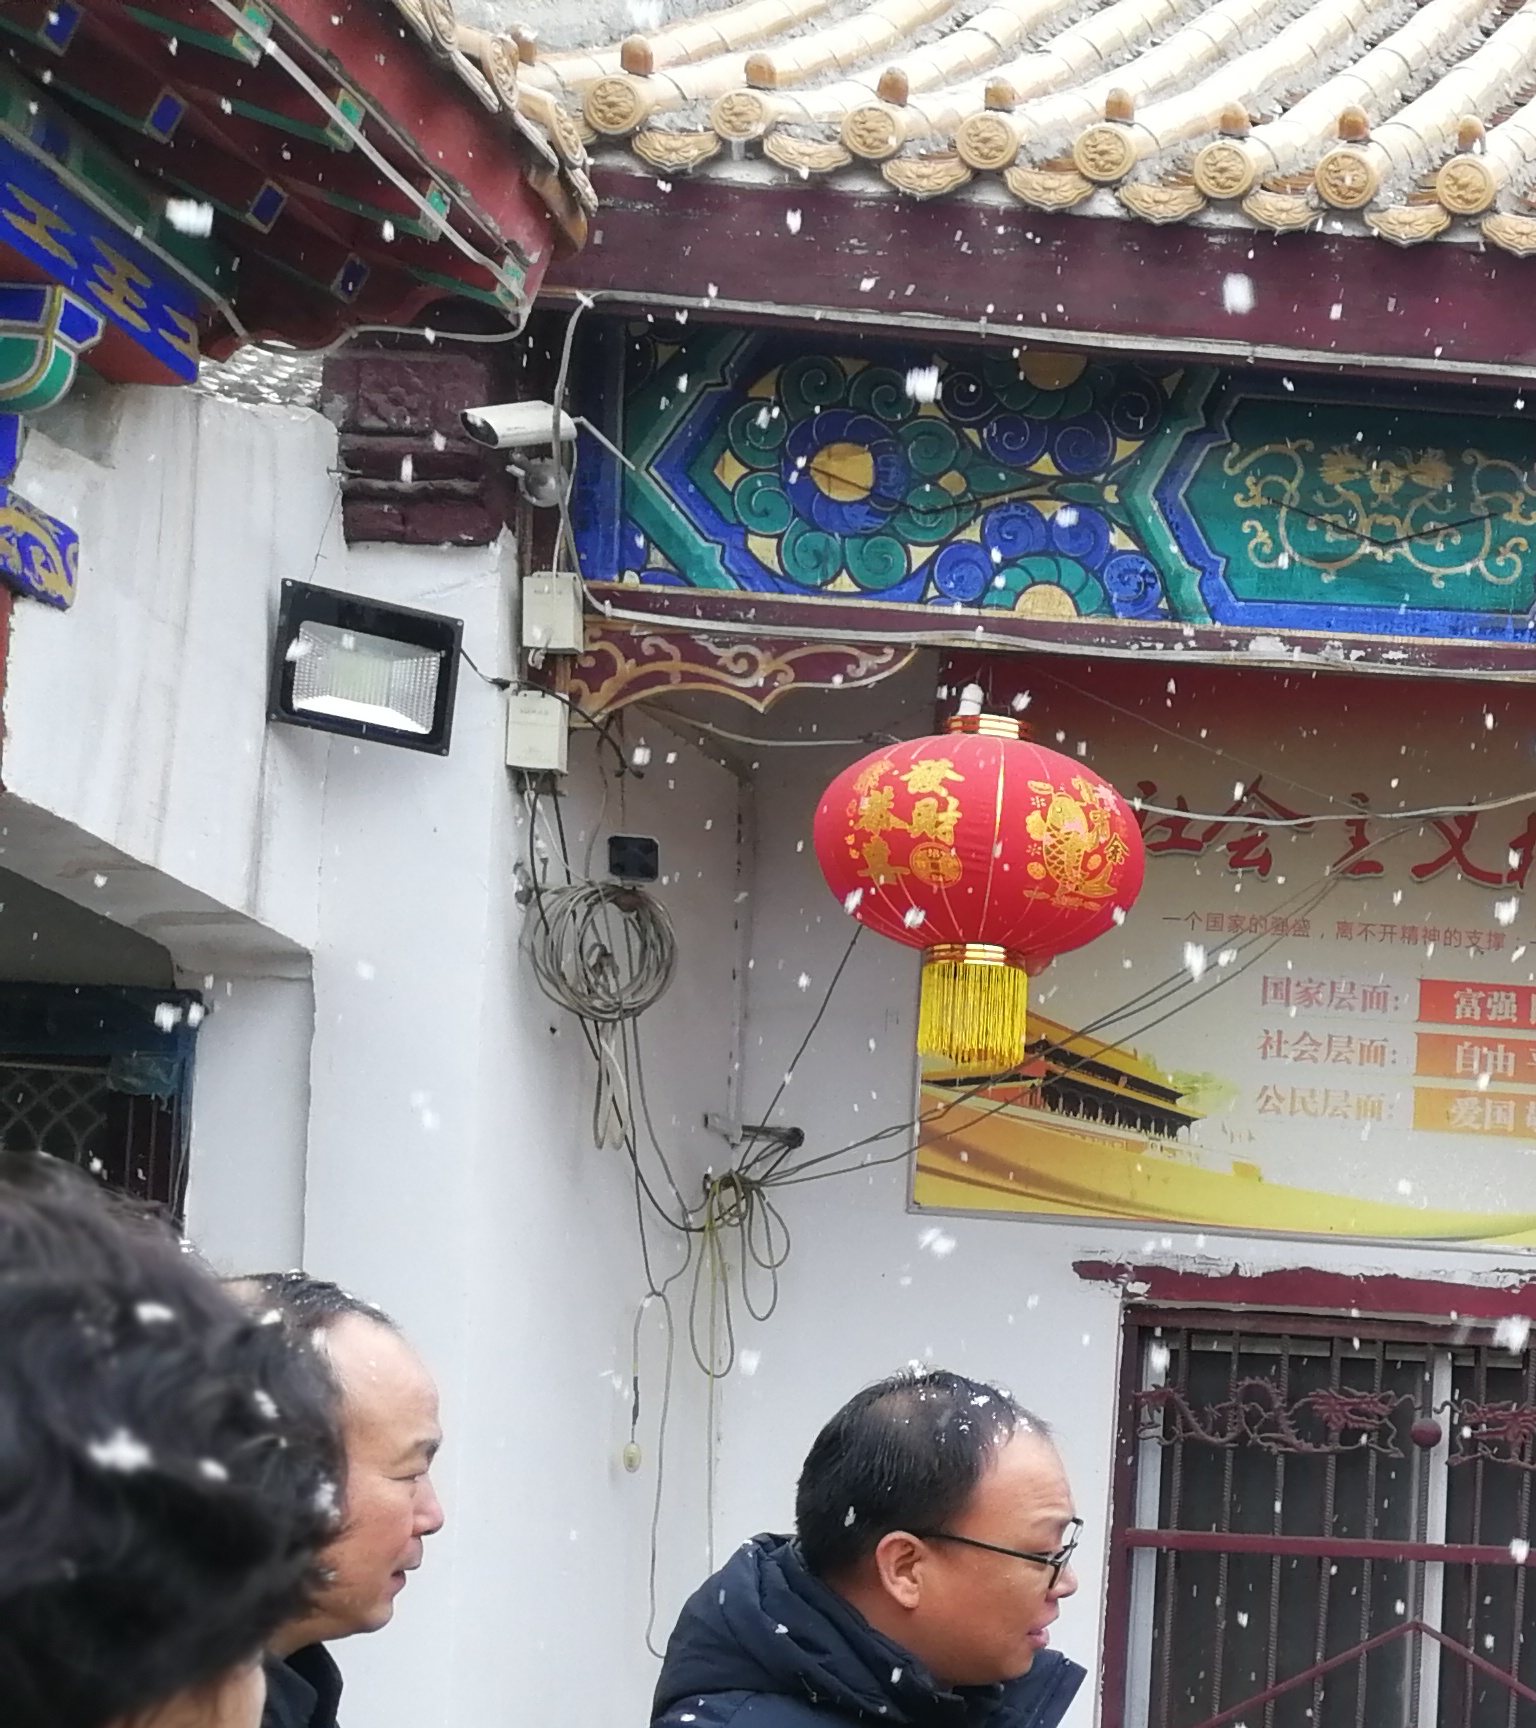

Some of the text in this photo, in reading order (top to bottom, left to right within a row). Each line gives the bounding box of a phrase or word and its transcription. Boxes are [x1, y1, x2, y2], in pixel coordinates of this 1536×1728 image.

[1453, 987, 1519, 1023] 富强
[1455, 1041, 1516, 1078] 自由
[1450, 1097, 1516, 1134] 爱国
